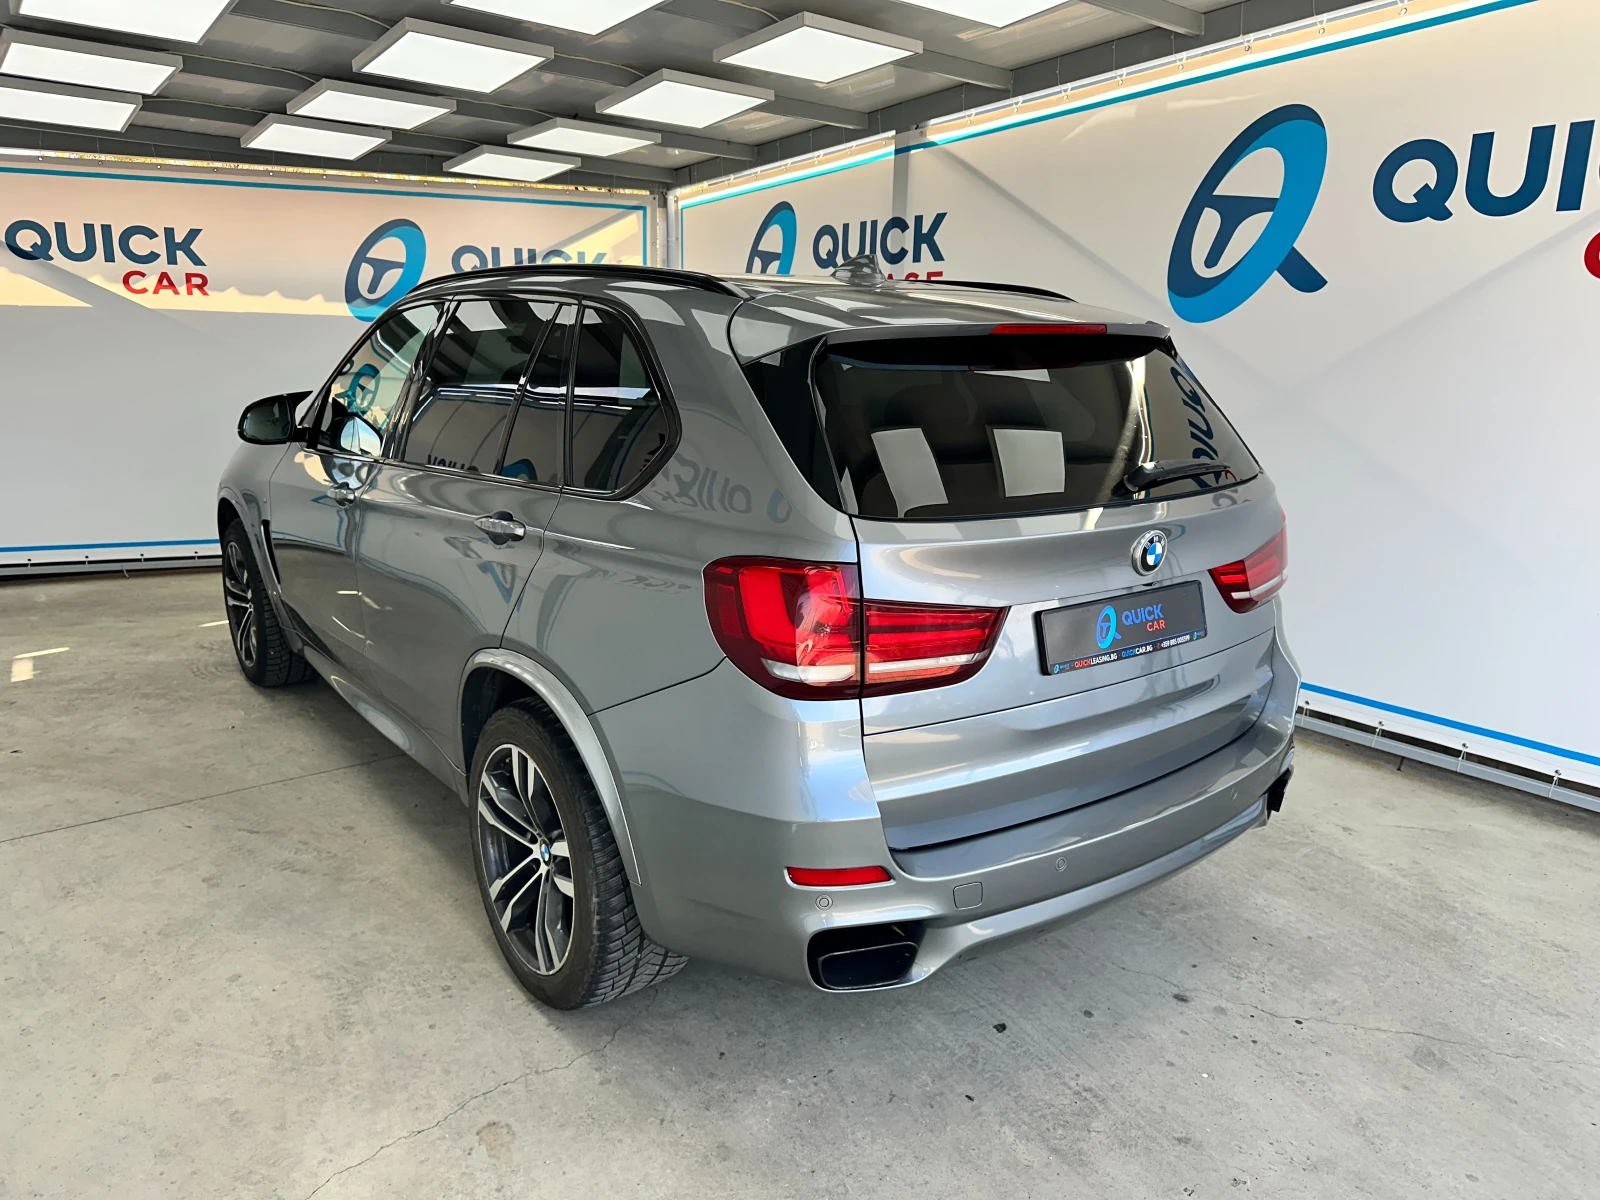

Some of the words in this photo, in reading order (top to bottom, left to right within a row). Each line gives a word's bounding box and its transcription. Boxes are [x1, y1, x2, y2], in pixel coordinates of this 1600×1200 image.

[1373, 119, 1600, 224] QUI
[4, 219, 207, 267] QUICK
[812, 211, 948, 270] QUICK
[122, 270, 210, 296] CAR
[1121, 603, 1164, 626] QUICK
[1146, 619, 1166, 632] CAR
